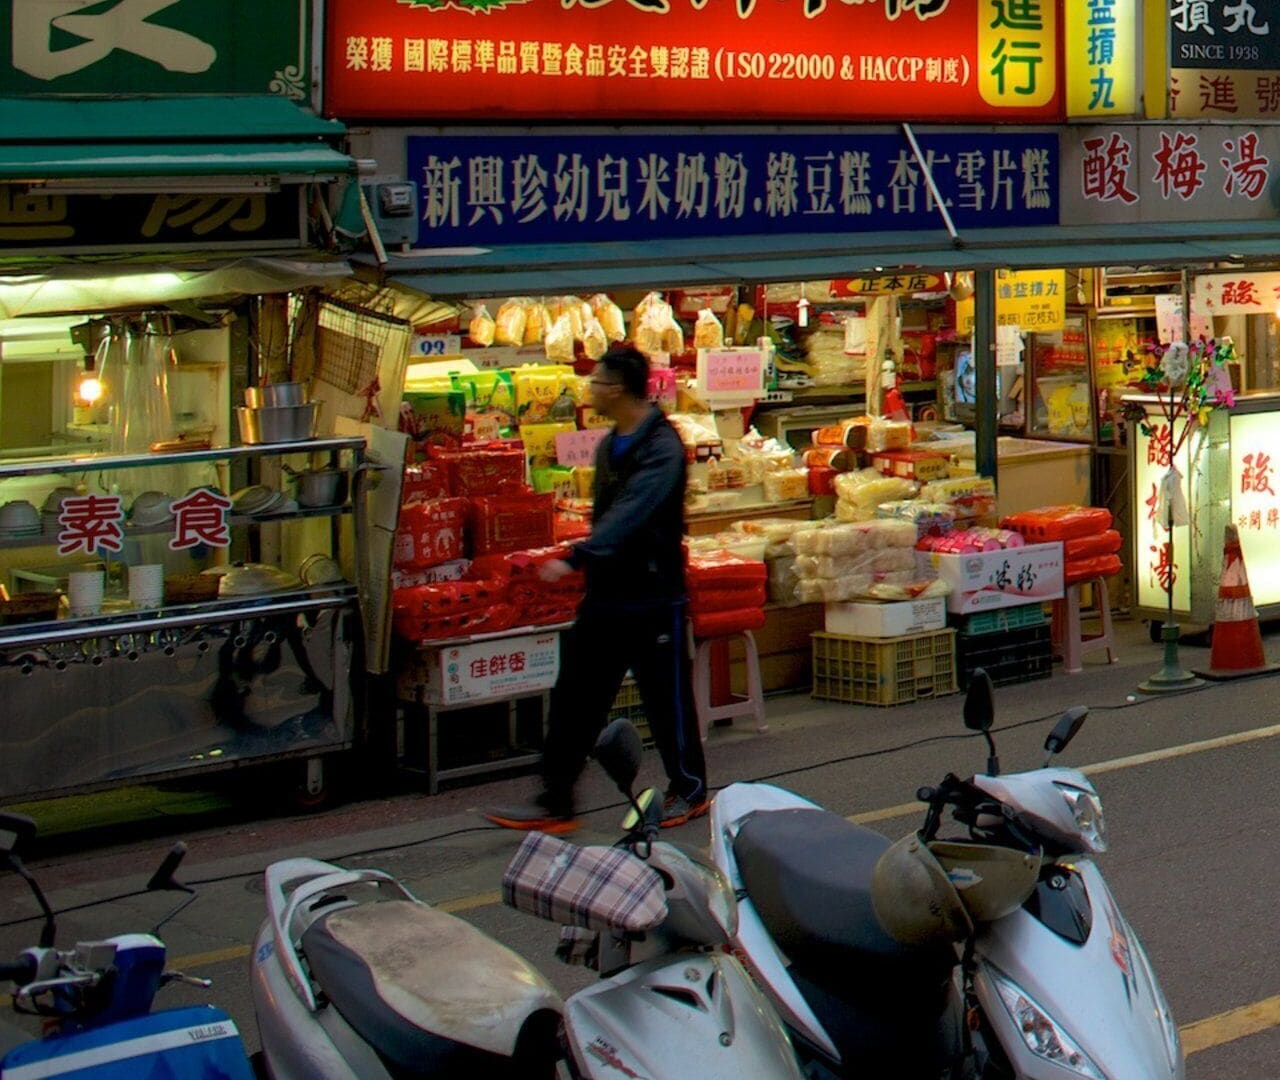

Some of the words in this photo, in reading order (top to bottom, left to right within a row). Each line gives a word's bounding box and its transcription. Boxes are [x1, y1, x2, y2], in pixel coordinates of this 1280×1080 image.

[346, 36, 393, 72] 榮獲
[714, 47, 766, 83] (ISO
[767, 51, 835, 81] 22000
[839, 53, 855, 81] &
[1180, 44, 1225, 60] SINCE
[1228, 45, 1260, 61] 1938
[1080, 130, 1270, 206] 酸梅湯
[860, 273, 928, 293] 正本店
[57, 486, 234, 555] 素食
